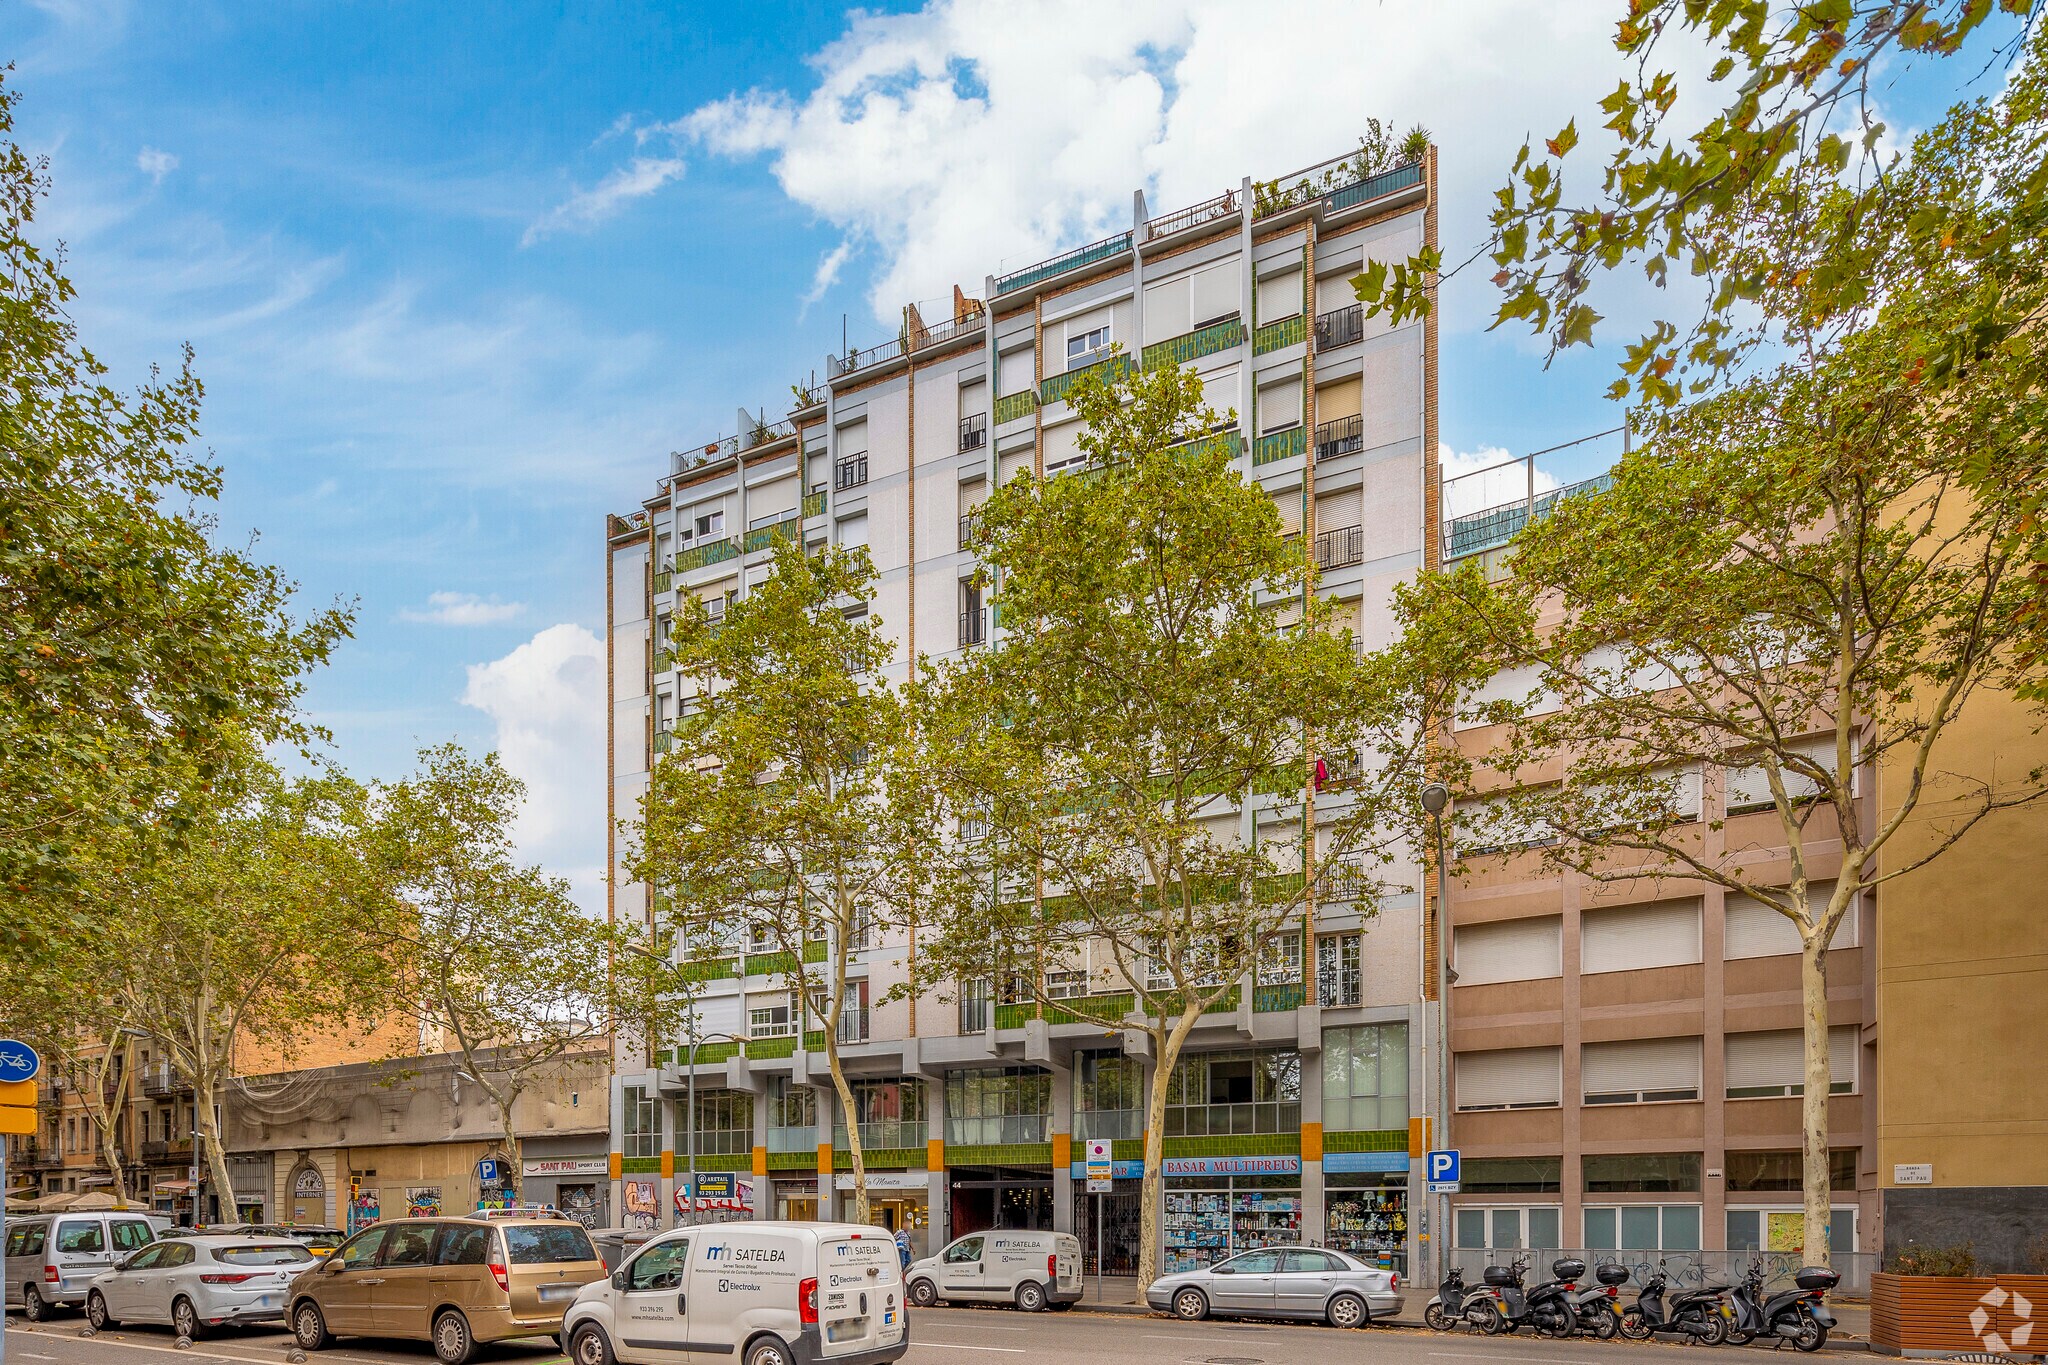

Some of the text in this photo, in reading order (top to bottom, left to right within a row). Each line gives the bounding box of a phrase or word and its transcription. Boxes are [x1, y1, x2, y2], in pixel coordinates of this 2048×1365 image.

[482, 1162, 493, 1178] P
[540, 1162, 559, 1171] SANT
[561, 1161, 577, 1170] PAU
[1167, 1159, 1298, 1173] BASAR MULTIPREUS
[1433, 1154, 1453, 1180] P
[297, 1170, 323, 1188] LOCUTORIO
[855, 1245, 882, 1255] SATELBA
[1012, 1240, 1041, 1248] SATELBA
[735, 1248, 786, 1262] SATELBA
[839, 1275, 862, 1283] Electrolux
[730, 1282, 761, 1291] Electrolux
